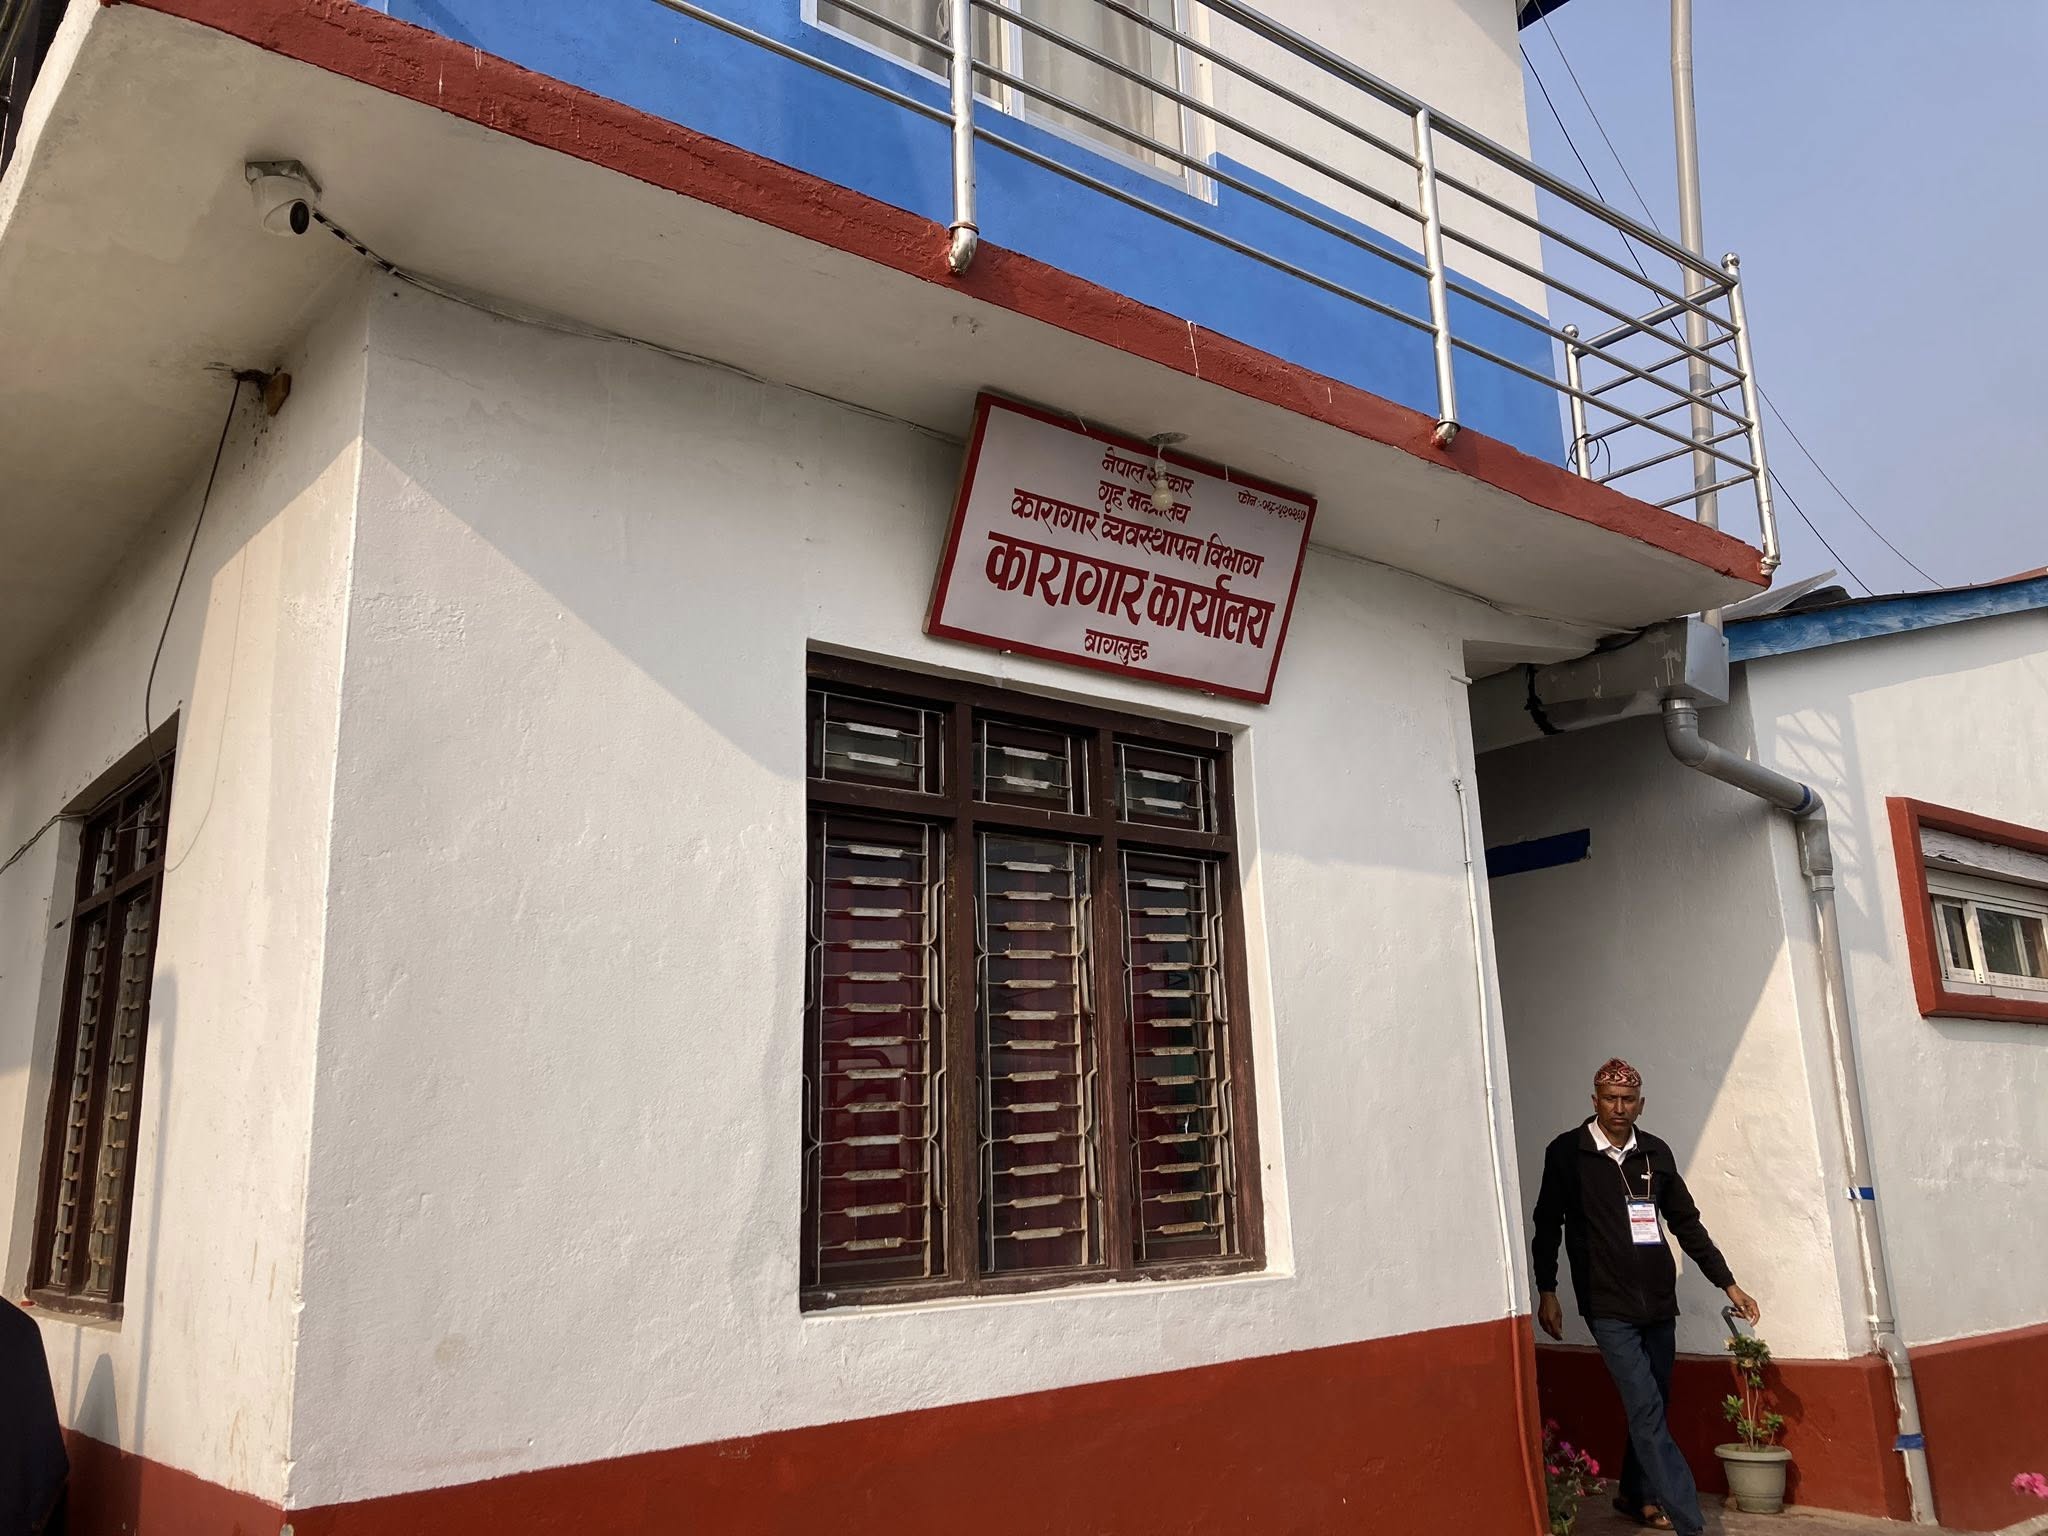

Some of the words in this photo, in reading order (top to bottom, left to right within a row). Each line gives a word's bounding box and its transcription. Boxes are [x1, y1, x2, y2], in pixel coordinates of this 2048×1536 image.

[1098, 480, 1127, 513] गृह
[1102, 447, 1148, 484] नेपाल
[1011, 488, 1100, 541] कारागार
[1101, 513, 1204, 564] व्यवस्थापन
[1203, 532, 1265, 579] विभाग
[985, 531, 1150, 626] कारागार
[1146, 574, 1276, 649] कार्यालय
